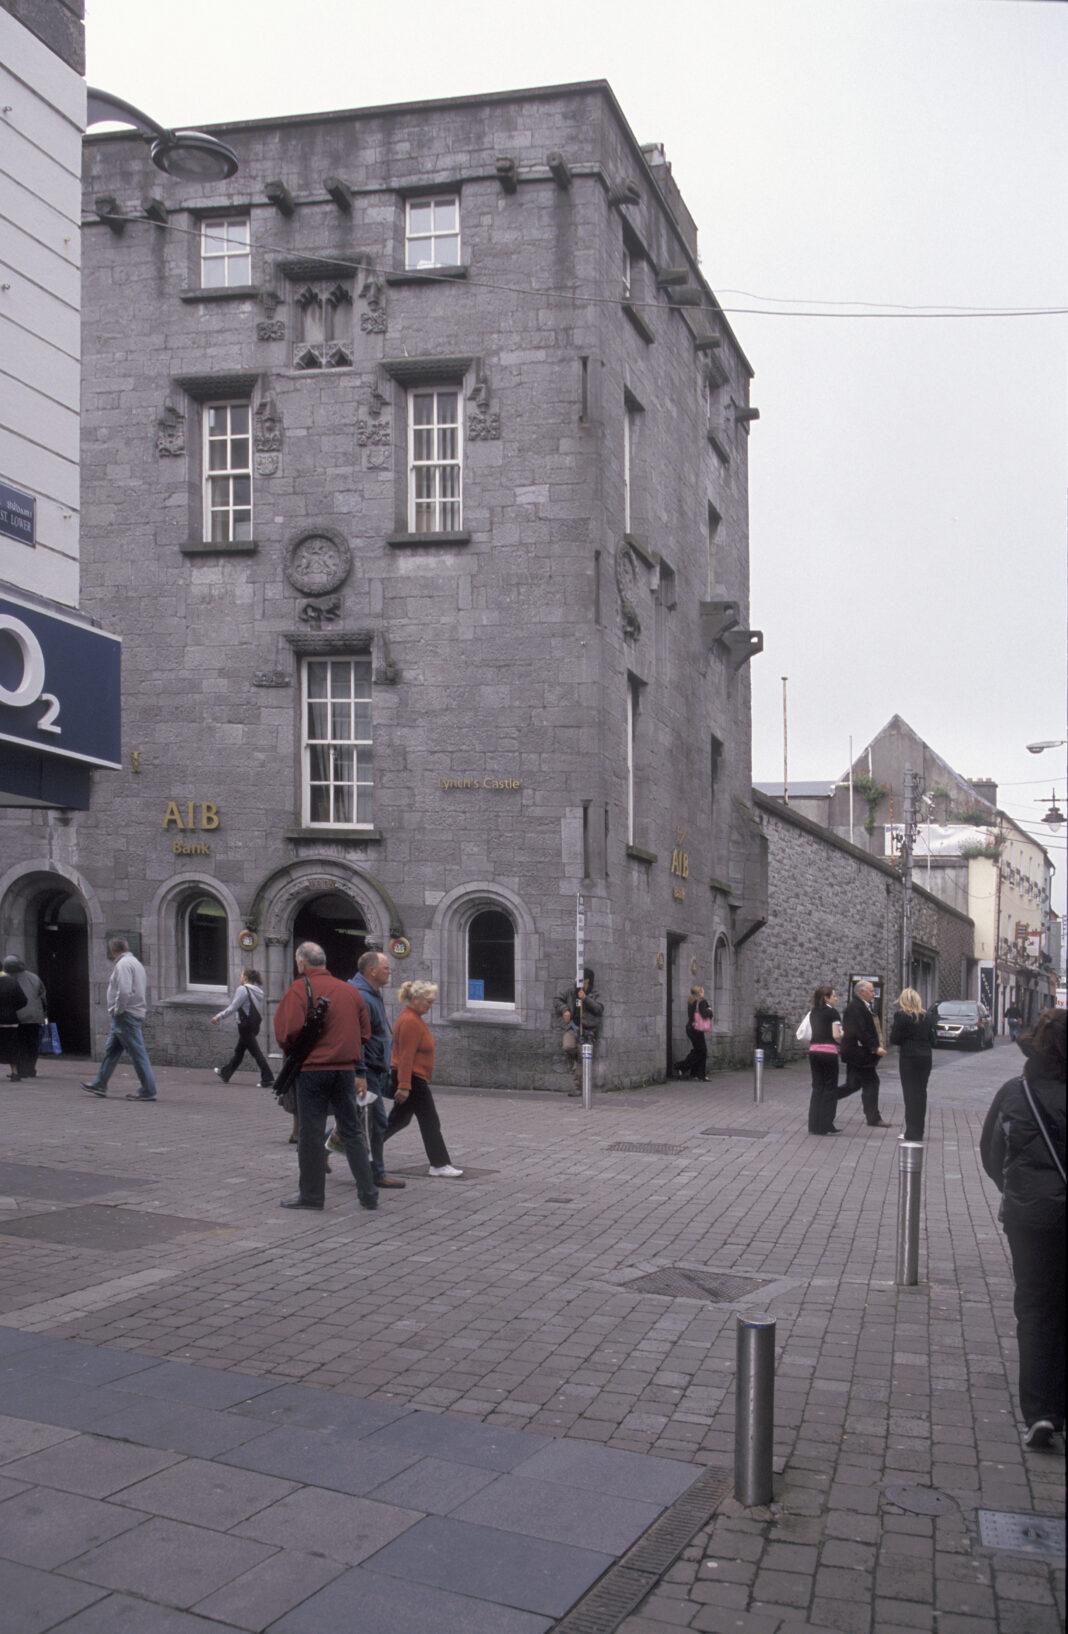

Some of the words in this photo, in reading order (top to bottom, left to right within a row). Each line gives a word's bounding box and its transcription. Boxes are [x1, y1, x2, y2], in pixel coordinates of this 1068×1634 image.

[10, 513, 32, 533] LOWER
[483, 776, 520, 790] Castle
[162, 801, 220, 830] AIB
[172, 840, 210, 855] Bank
[671, 847, 689, 879] AIB
